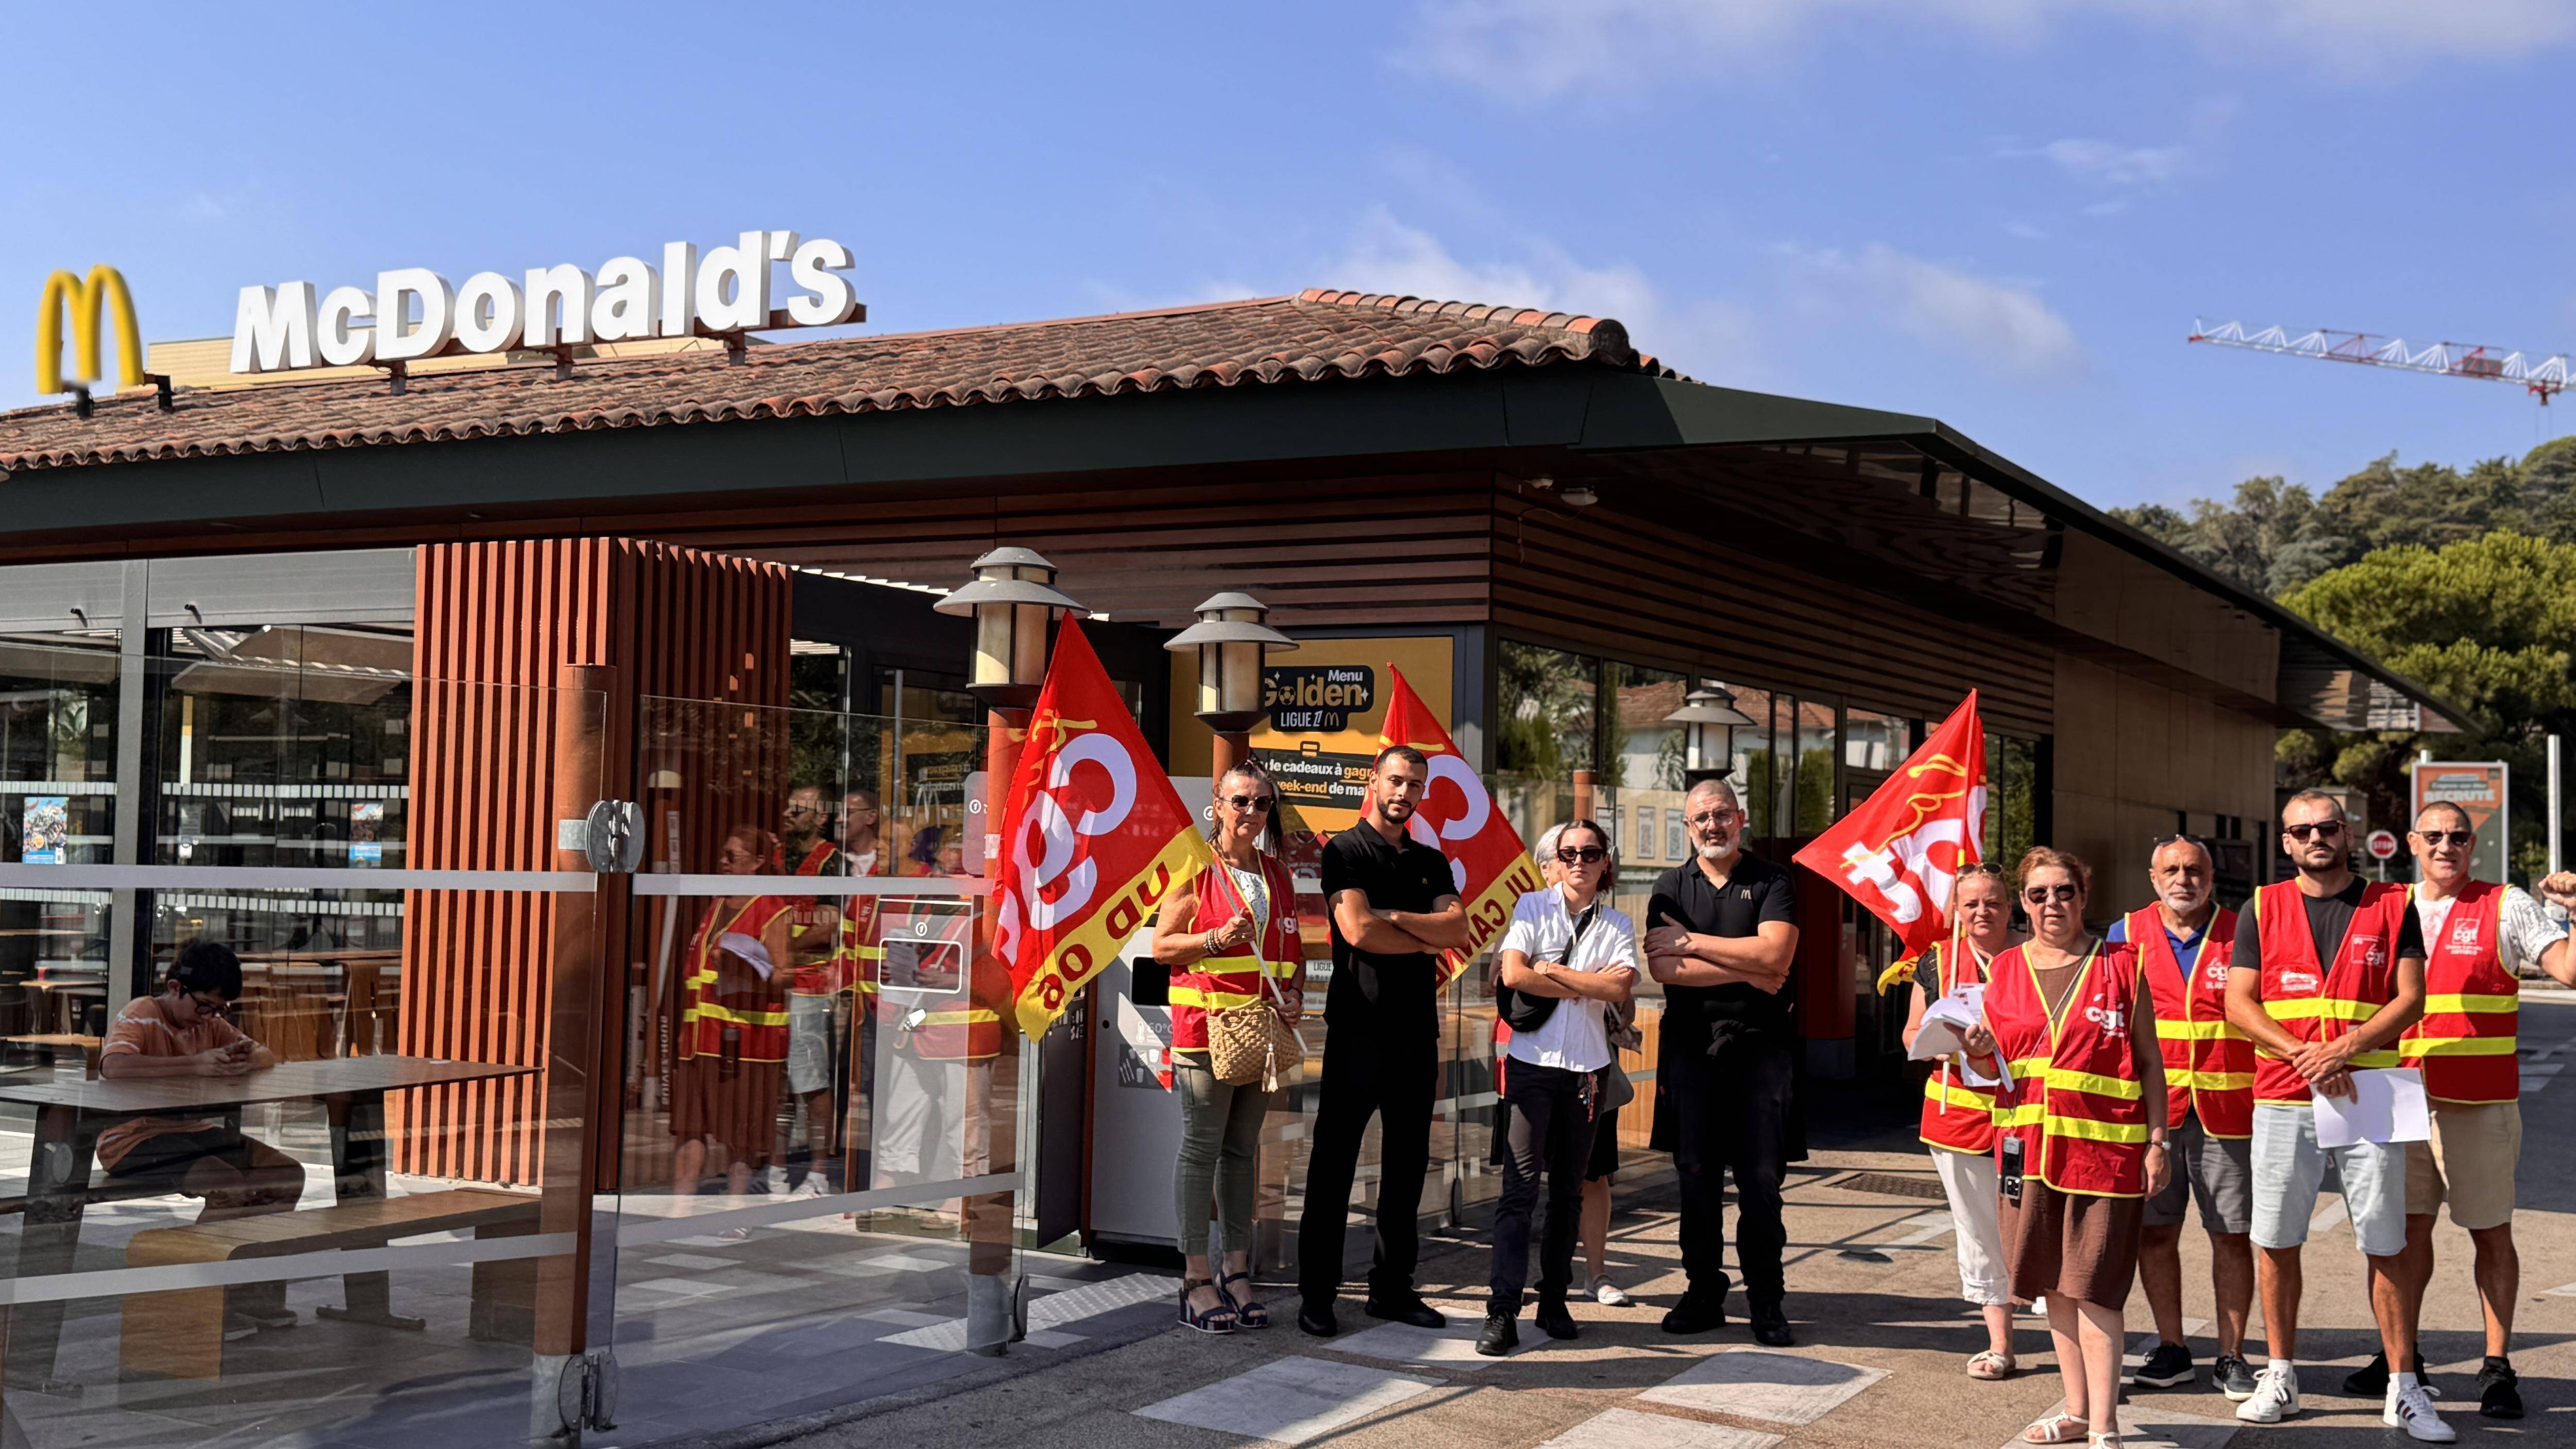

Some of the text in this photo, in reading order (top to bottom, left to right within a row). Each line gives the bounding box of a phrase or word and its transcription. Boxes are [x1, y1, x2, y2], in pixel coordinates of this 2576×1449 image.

[230, 230, 856, 373] McDonald's
[1328, 669, 1363, 682] Menu
[1280, 712, 1312, 727] LIGUE
[1283, 761, 1333, 775] cadeaux
[1334, 763, 1342, 776] à
[1329, 782, 1344, 795] de
[2424, 789, 2494, 802] RECRUTE
[2085, 1002, 2125, 1030] cgt
